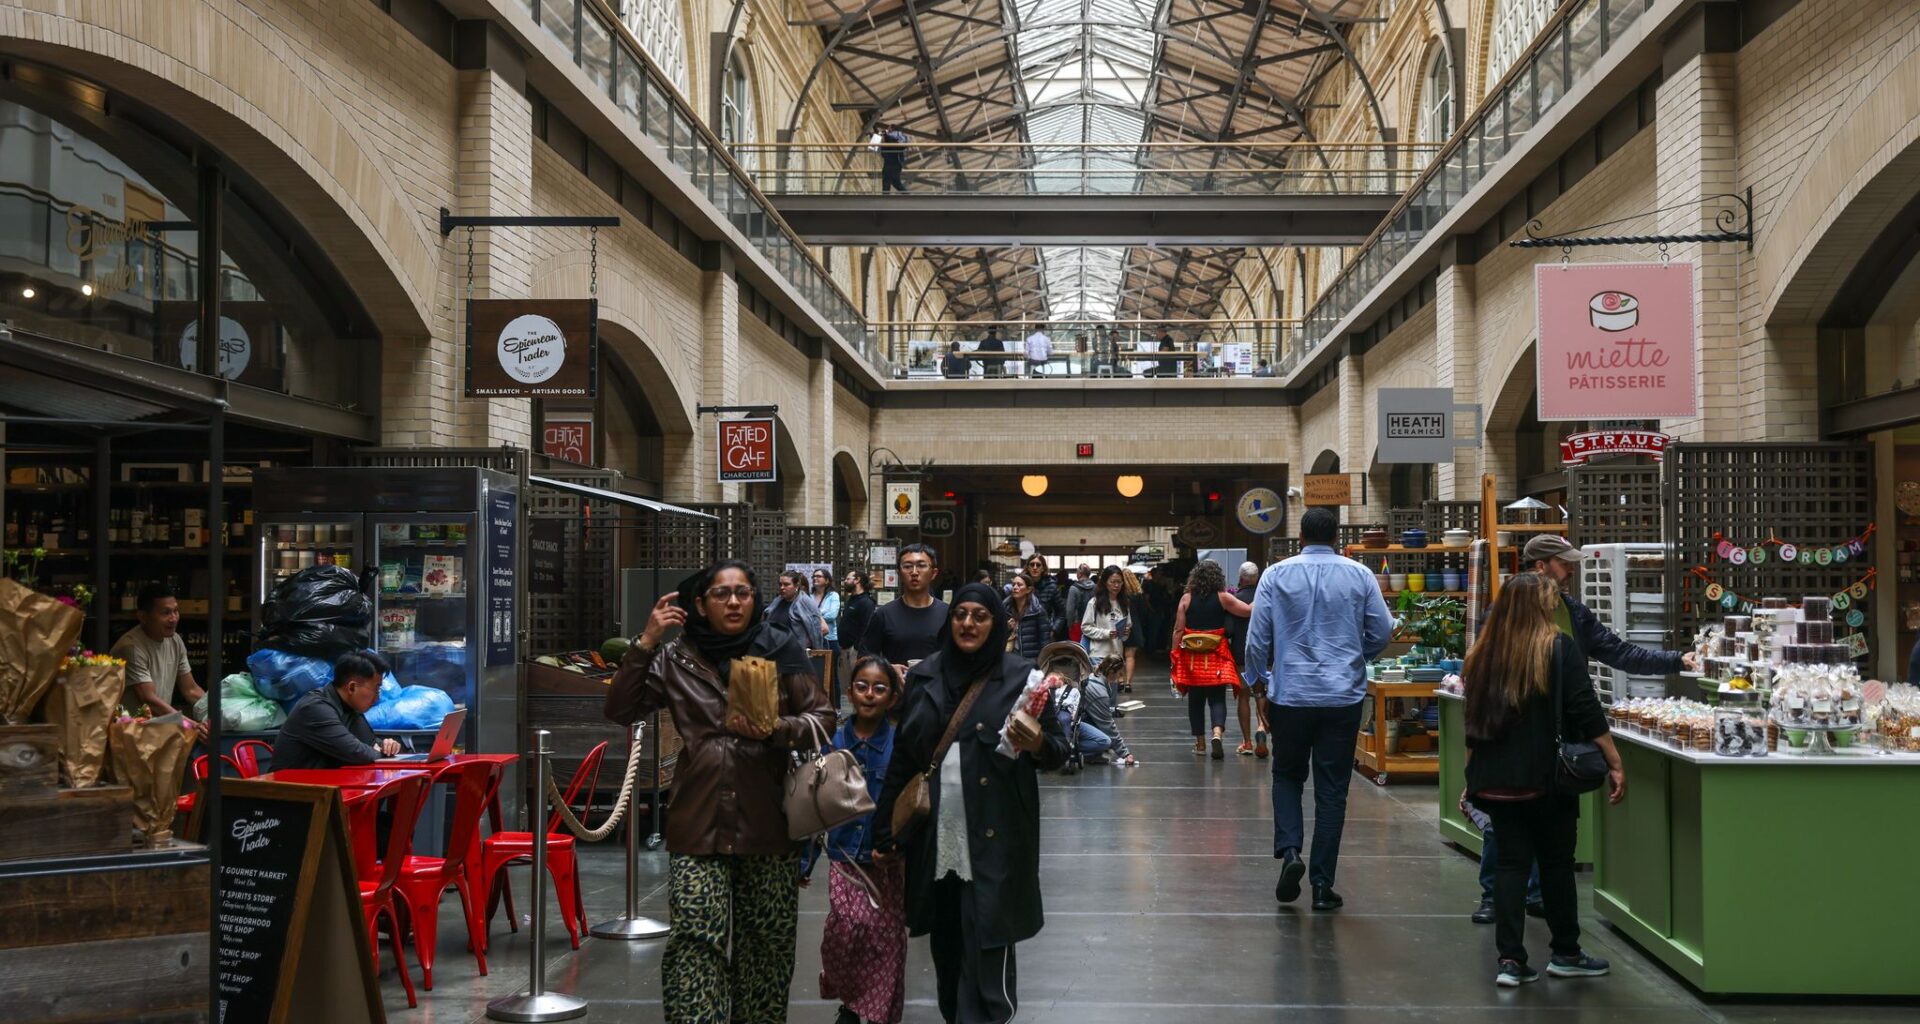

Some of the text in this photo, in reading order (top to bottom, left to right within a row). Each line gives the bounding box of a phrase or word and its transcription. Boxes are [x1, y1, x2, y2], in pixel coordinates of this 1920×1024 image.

[503, 334, 559, 354] Epicurean
[511, 347, 551, 364] Trader
[1566, 338, 1671, 370] miette
[1569, 374, 1666, 390] PÂTISSERIE
[1391, 416, 1441, 428] HEATH
[726, 425, 768, 446] FATTED
[1390, 428, 1441, 436] CERAMICS
[1573, 434, 1664, 449] STRAUS
[727, 445, 766, 469] CALF
[1305, 478, 1349, 488] DANDELION
[925, 517, 951, 530] A16
[1720, 543, 1864, 564] ICE CREAM
[232, 818, 282, 838] Epicurean
[238, 832, 271, 854] Trader
[225, 866, 258, 877] GOURMET
[227, 890, 252, 901] SPIRITS
[219, 923, 232, 932] INE
